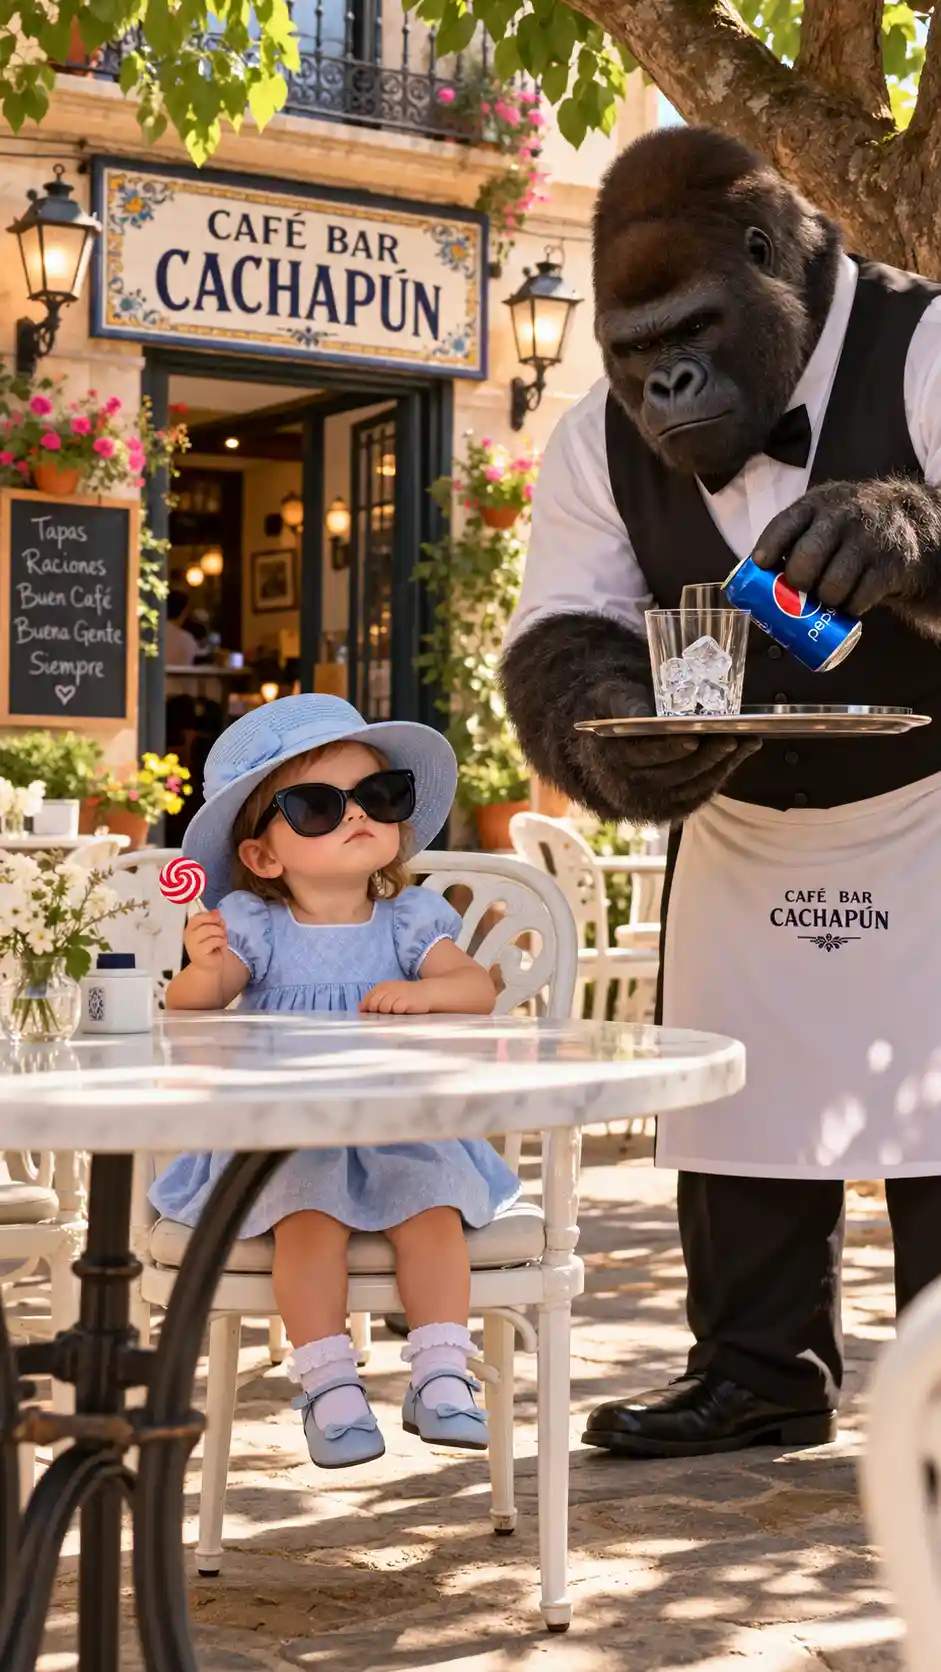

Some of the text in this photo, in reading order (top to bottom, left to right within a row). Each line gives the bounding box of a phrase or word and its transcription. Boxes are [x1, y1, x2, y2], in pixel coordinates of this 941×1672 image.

[207, 210, 399, 264] CAFÉ BAR
[154, 247, 442, 341] CACHAPÚN
[30, 515, 88, 549] Tapas
[21, 548, 107, 576] Raciones
[16, 582, 113, 616] Buen Café
[13, 616, 123, 647] Buena Gente
[28, 650, 105, 686] Siempre
[784, 887, 873, 904] CAFÉ BAR
[770, 905, 889, 930] CACHAPÚN
